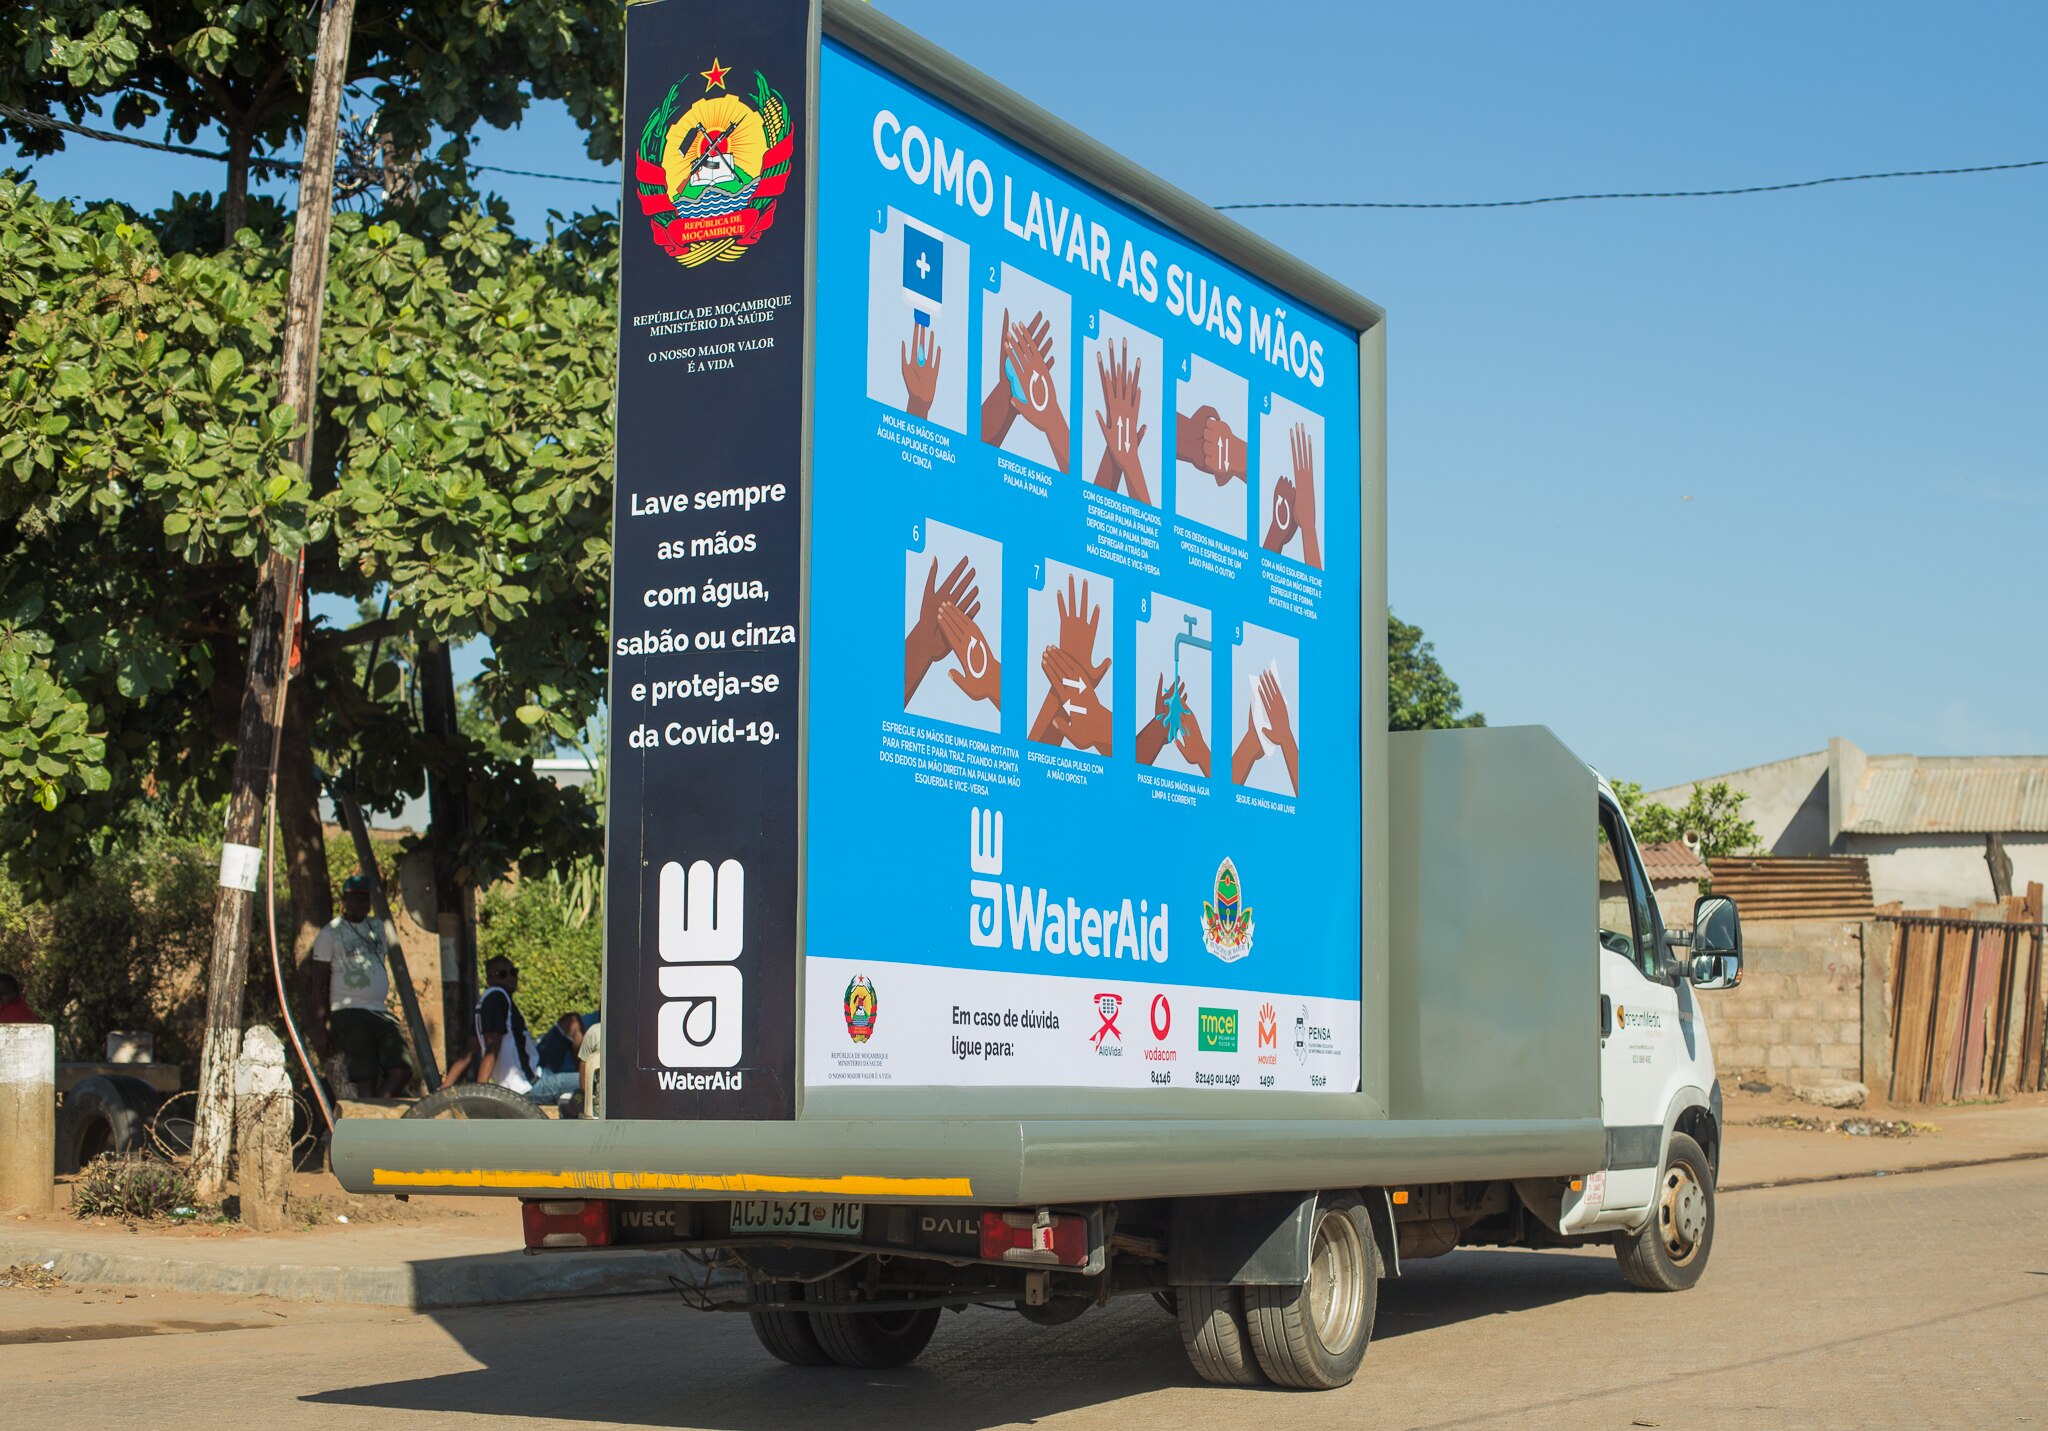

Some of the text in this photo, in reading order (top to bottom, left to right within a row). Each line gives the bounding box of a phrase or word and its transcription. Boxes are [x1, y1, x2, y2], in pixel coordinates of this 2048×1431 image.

[684, 214, 742, 230] REPÚBLICA DE
[877, 210, 881, 224] 1
[681, 225, 745, 241] MOÇAMBIQUE
[873, 109, 1325, 388] COMO LAVAR AS SUAS MÃOS
[989, 267, 995, 282] 2
[633, 295, 792, 326] REPÚBLICA DE MOÇAMBIQUE
[650, 310, 774, 337] MINISTÉRIO DA SAÚDE
[1089, 315, 1095, 329] 3
[648, 337, 774, 362] O NOSSO MAIOR VALOR
[688, 358, 734, 373] É A VIDA
[1181, 359, 1186, 372] 4
[1264, 396, 1268, 407] 5
[883, 414, 949, 447] MOLHE AS MÃOS COM
[877, 425, 955, 463] ÁGUA E APLIQUE O SABÃO
[902, 451, 932, 470] OU CINZA
[1028, 469, 1035, 479] AS
[1004, 474, 1023, 489] PALMA
[1029, 483, 1048, 498] PALMA
[631, 483, 786, 516] Lave sempre
[1083, 490, 1095, 501] COM
[1096, 495, 1103, 504] OS
[1104, 497, 1121, 511] DEDOS
[913, 526, 919, 541] 6
[1106, 525, 1118, 536] COM
[1155, 529, 1158, 537] E
[658, 530, 756, 560] as mãos
[1034, 565, 1039, 579] 7
[644, 578, 768, 608] com água,
[1141, 598, 1146, 612] 8
[616, 622, 796, 656] sabão ou cinza
[1236, 626, 1240, 638] 9
[631, 672, 779, 706] e proteja-se
[629, 718, 779, 748] da Covid-19.
[882, 721, 1019, 759] ESFREGUE AS MÃOS DE UMA FORMA ROTATIVA
[882, 736, 900, 749] PARA
[901, 740, 925, 754] FRENTE
[927, 745, 930, 755] E
[932, 746, 948, 758] PARA
[967, 754, 992, 768] FIXANDO
[994, 759, 998, 768] A
[999, 760, 1018, 773] PONTA
[1028, 752, 1103, 775] ESFREGUE CADA PULSO COM
[880, 751, 1020, 787] DOS DEDOS DA MÃO DIREITA NA PALMA DA MÃO
[1047, 769, 1087, 785] A MÃO OPOSTA
[915, 773, 989, 796] ESQUERDA E VICE-VERSA
[1154, 778, 1160, 786] AS
[1006, 884, 1168, 963] WaterAid
[953, 1006, 1059, 1029] Em caso de dúvida
[1309, 1027, 1331, 1040] PENSA
[952, 1036, 1014, 1060] ligue para:
[1144, 1047, 1176, 1061] vodacom
[658, 1072, 742, 1090] WaterAid
[1216, 1074, 1223, 1083] ou
[1225, 1073, 1239, 1086] 1490
[1260, 1076, 1274, 1087] 1490
[732, 1201, 768, 1226] ACJ
[832, 1203, 859, 1229] MC
[922, 1217, 980, 1234] DAIL
